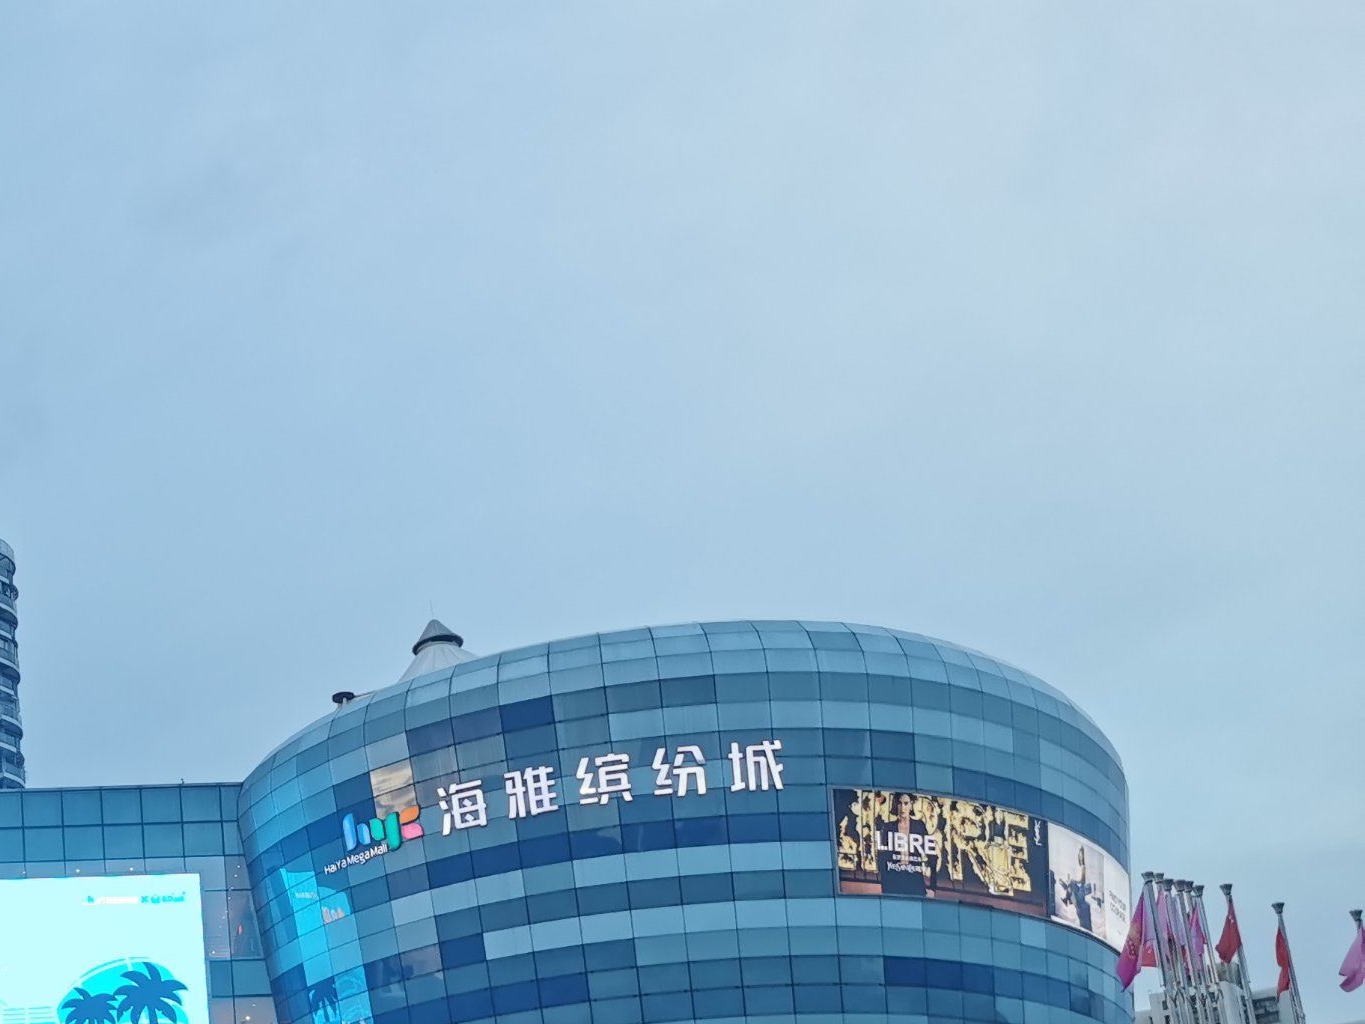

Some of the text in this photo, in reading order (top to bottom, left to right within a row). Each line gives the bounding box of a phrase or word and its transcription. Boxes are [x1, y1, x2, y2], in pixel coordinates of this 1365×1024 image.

[436, 738, 785, 837] 海雅缤纷城
[874, 830, 938, 856] LIBRE
